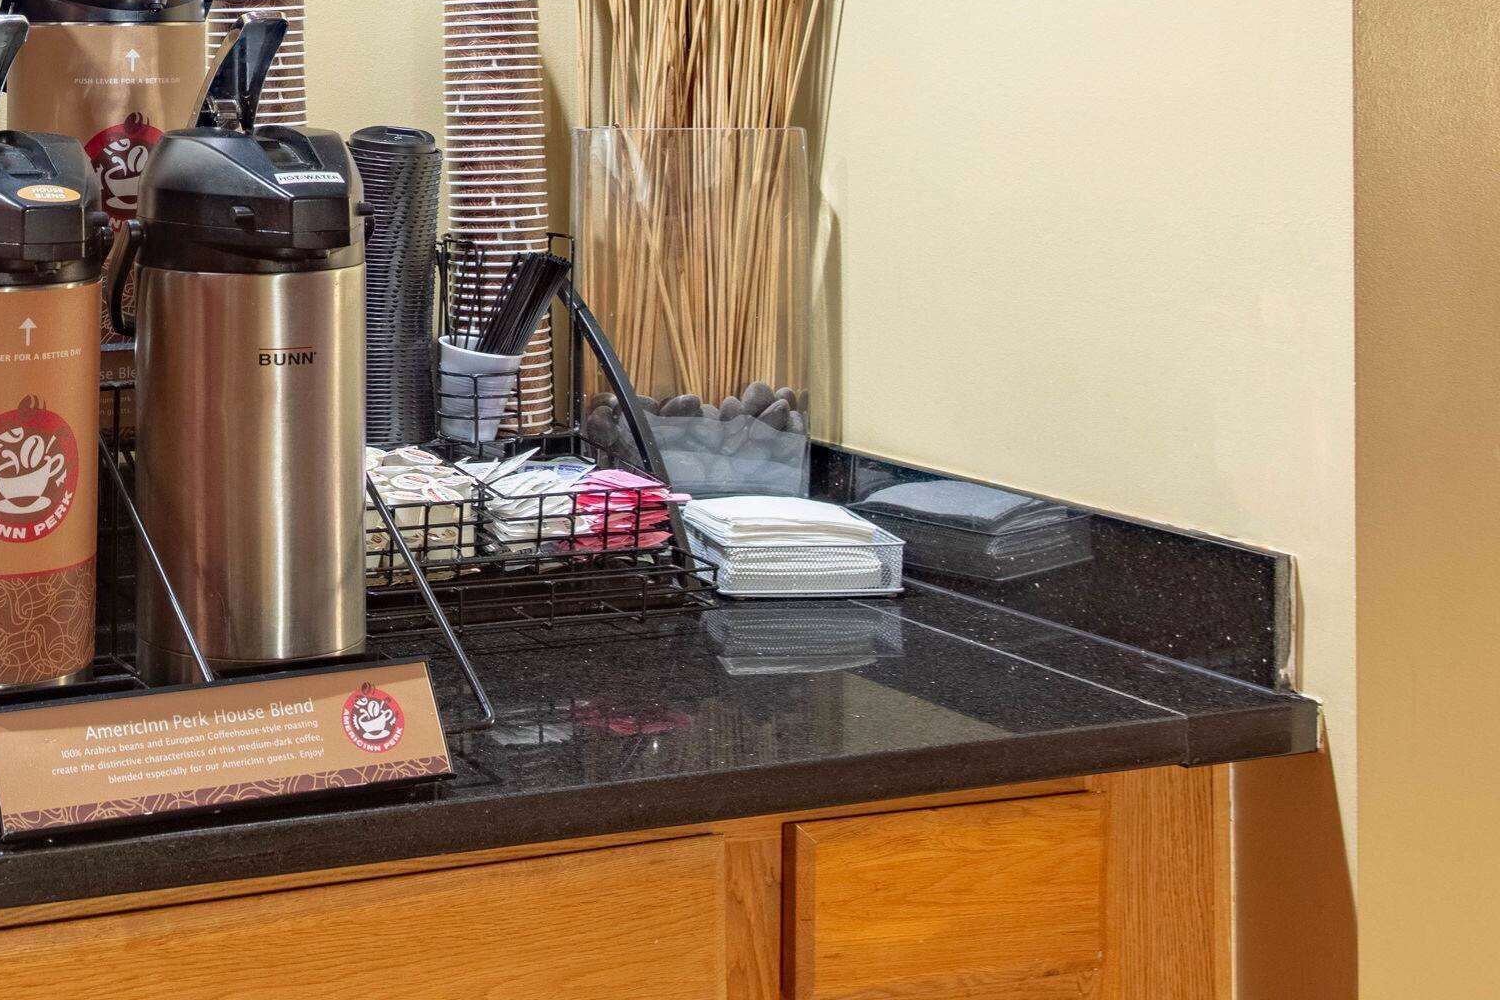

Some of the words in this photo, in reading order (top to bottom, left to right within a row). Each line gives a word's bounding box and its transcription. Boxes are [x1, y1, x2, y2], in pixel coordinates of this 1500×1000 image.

[13, 354, 31, 362] FOR
[33, 353, 41, 361] A
[41, 349, 69, 360] BETTER
[70, 348, 82, 357] DAY
[119, 366, 136, 379] Ble
[259, 352, 313, 366] BUNN
[33, 489, 74, 536] PERK
[85, 718, 169, 741] AmericInn
[173, 710, 210, 730] Perk
[214, 707, 265, 725] House
[270, 697, 315, 718] Blend
[343, 708, 382, 752] AMERICINN
[383, 727, 403, 750] PERK
[52, 765, 79, 776] create
[81, 762, 96, 772] the
[98, 757, 142, 770] distinctive
[144, 748, 206, 764] characteristics
[207, 745, 218, 756] of
[219, 743, 236, 754] this
[238, 737, 292, 752] medium-dark
[60, 748, 81, 759] 100%
[84, 745, 117, 757] Arabica
[119, 741, 145, 752] beans
[147, 738, 164, 749] and
[165, 734, 205, 747] European
[284, 719, 319, 731] roasting
[108, 770, 143, 784] blended
[145, 765, 188, 780] especially
[189, 764, 202, 774] for
[205, 762, 219, 772] our
[300, 747, 325, 760] Enjoy!
